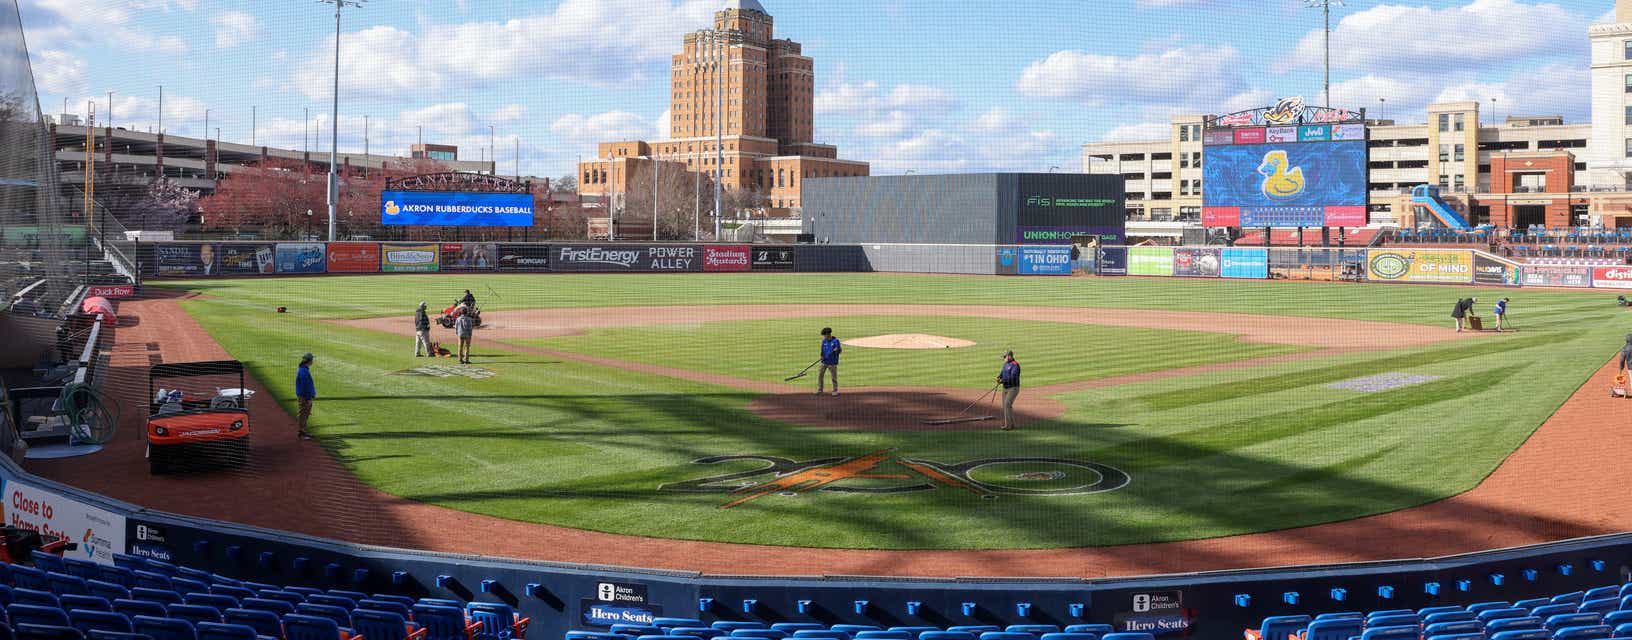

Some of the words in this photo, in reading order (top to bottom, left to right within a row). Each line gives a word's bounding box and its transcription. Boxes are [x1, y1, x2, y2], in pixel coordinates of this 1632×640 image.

[402, 174, 457, 189] CANAL
[471, 176, 514, 190] PARK
[402, 204, 434, 213] AKRON
[435, 205, 493, 214] RUBBERDUCKS
[494, 206, 531, 214] BASEBALL
[559, 247, 639, 264] FirstEnergy
[649, 247, 694, 258] POWER
[707, 248, 746, 259] Stadium
[651, 258, 691, 269] ALLEY
[1046, 254, 1069, 264] OHIO
[1420, 264, 1436, 273] OF
[1438, 264, 1468, 273] MIND
[95, 288, 112, 296] Duck
[114, 287, 129, 295] Row
[13, 490, 39, 515] Close
[42, 500, 53, 519] to
[133, 545, 150, 557] Hero
[151, 548, 170, 561] Seats
[615, 586, 632, 594] Akron
[615, 593, 643, 602] Children's
[1151, 601, 1179, 610] Children's
[591, 607, 619, 620] Hero
[622, 610, 653, 623] Seats
[1126, 620, 1155, 631] Hero
[1158, 618, 1189, 629] Seats
